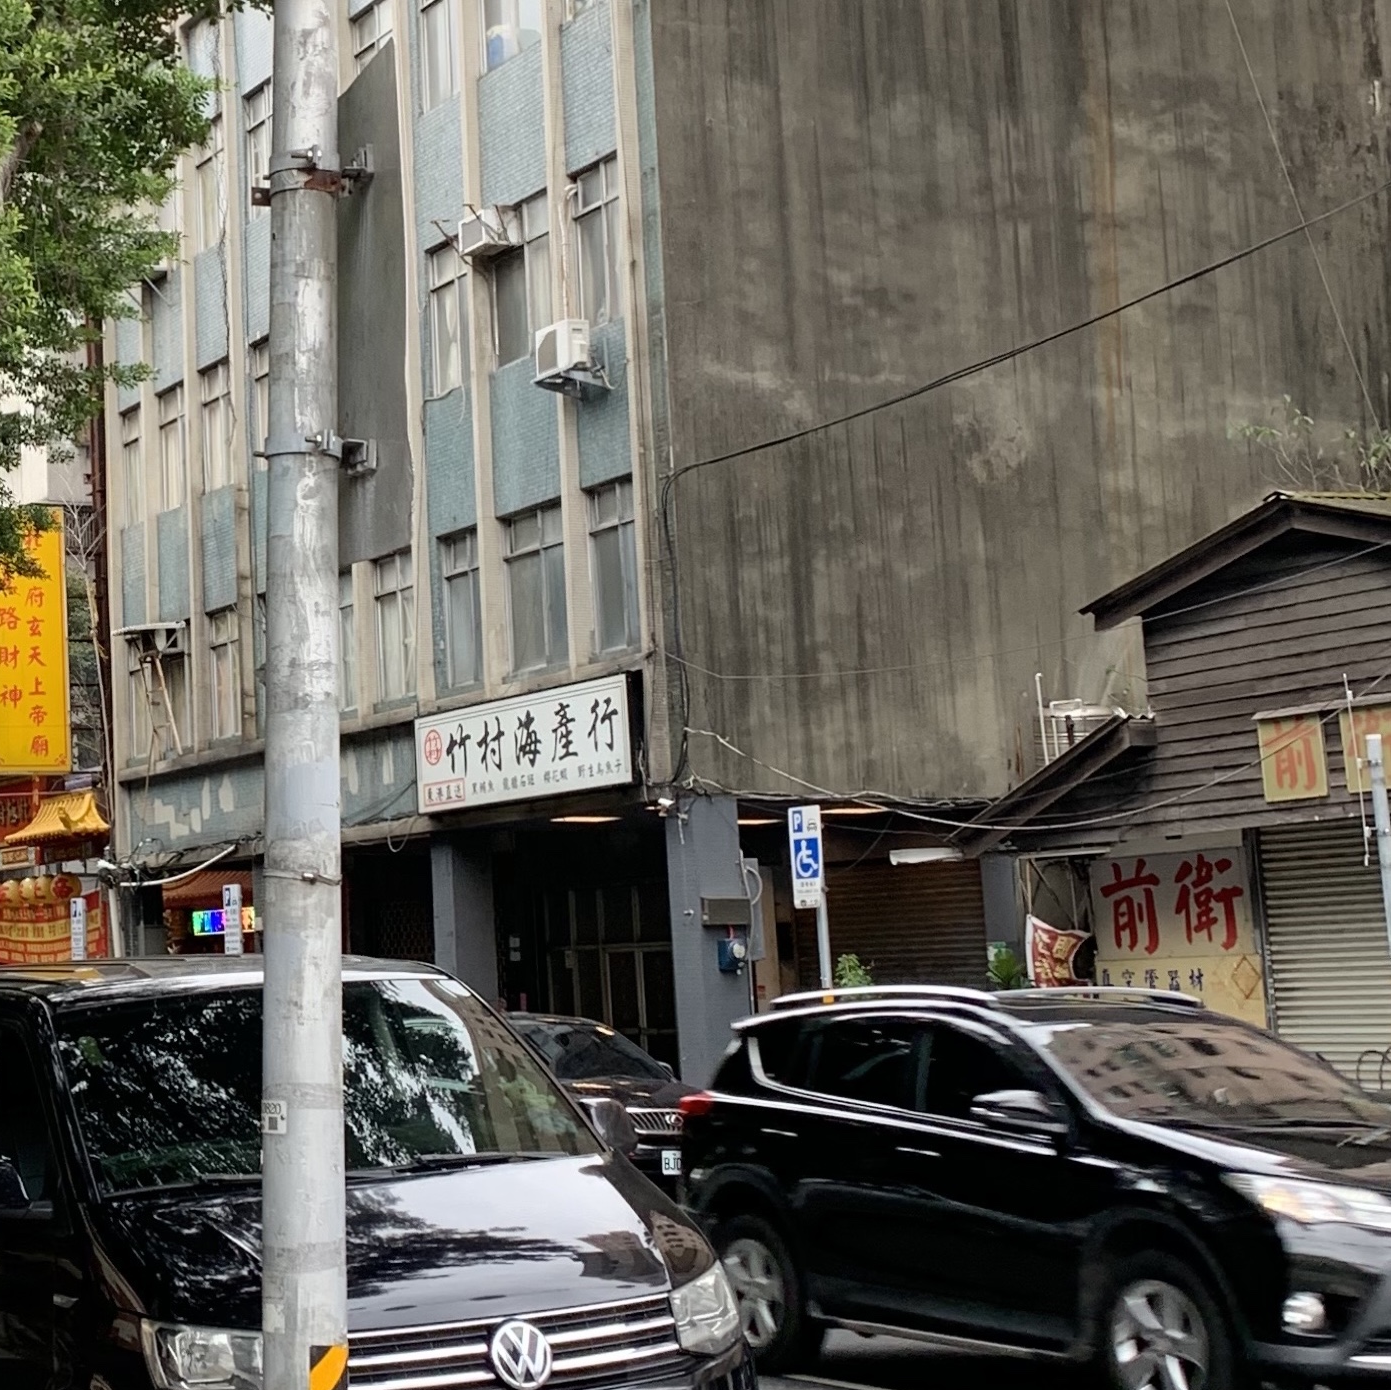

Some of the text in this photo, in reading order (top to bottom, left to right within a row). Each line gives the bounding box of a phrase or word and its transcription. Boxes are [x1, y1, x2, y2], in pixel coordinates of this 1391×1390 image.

[446, 697, 619, 777] 竹村海產行
[793, 812, 802, 831] P
[1100, 853, 1244, 955] 前衛
